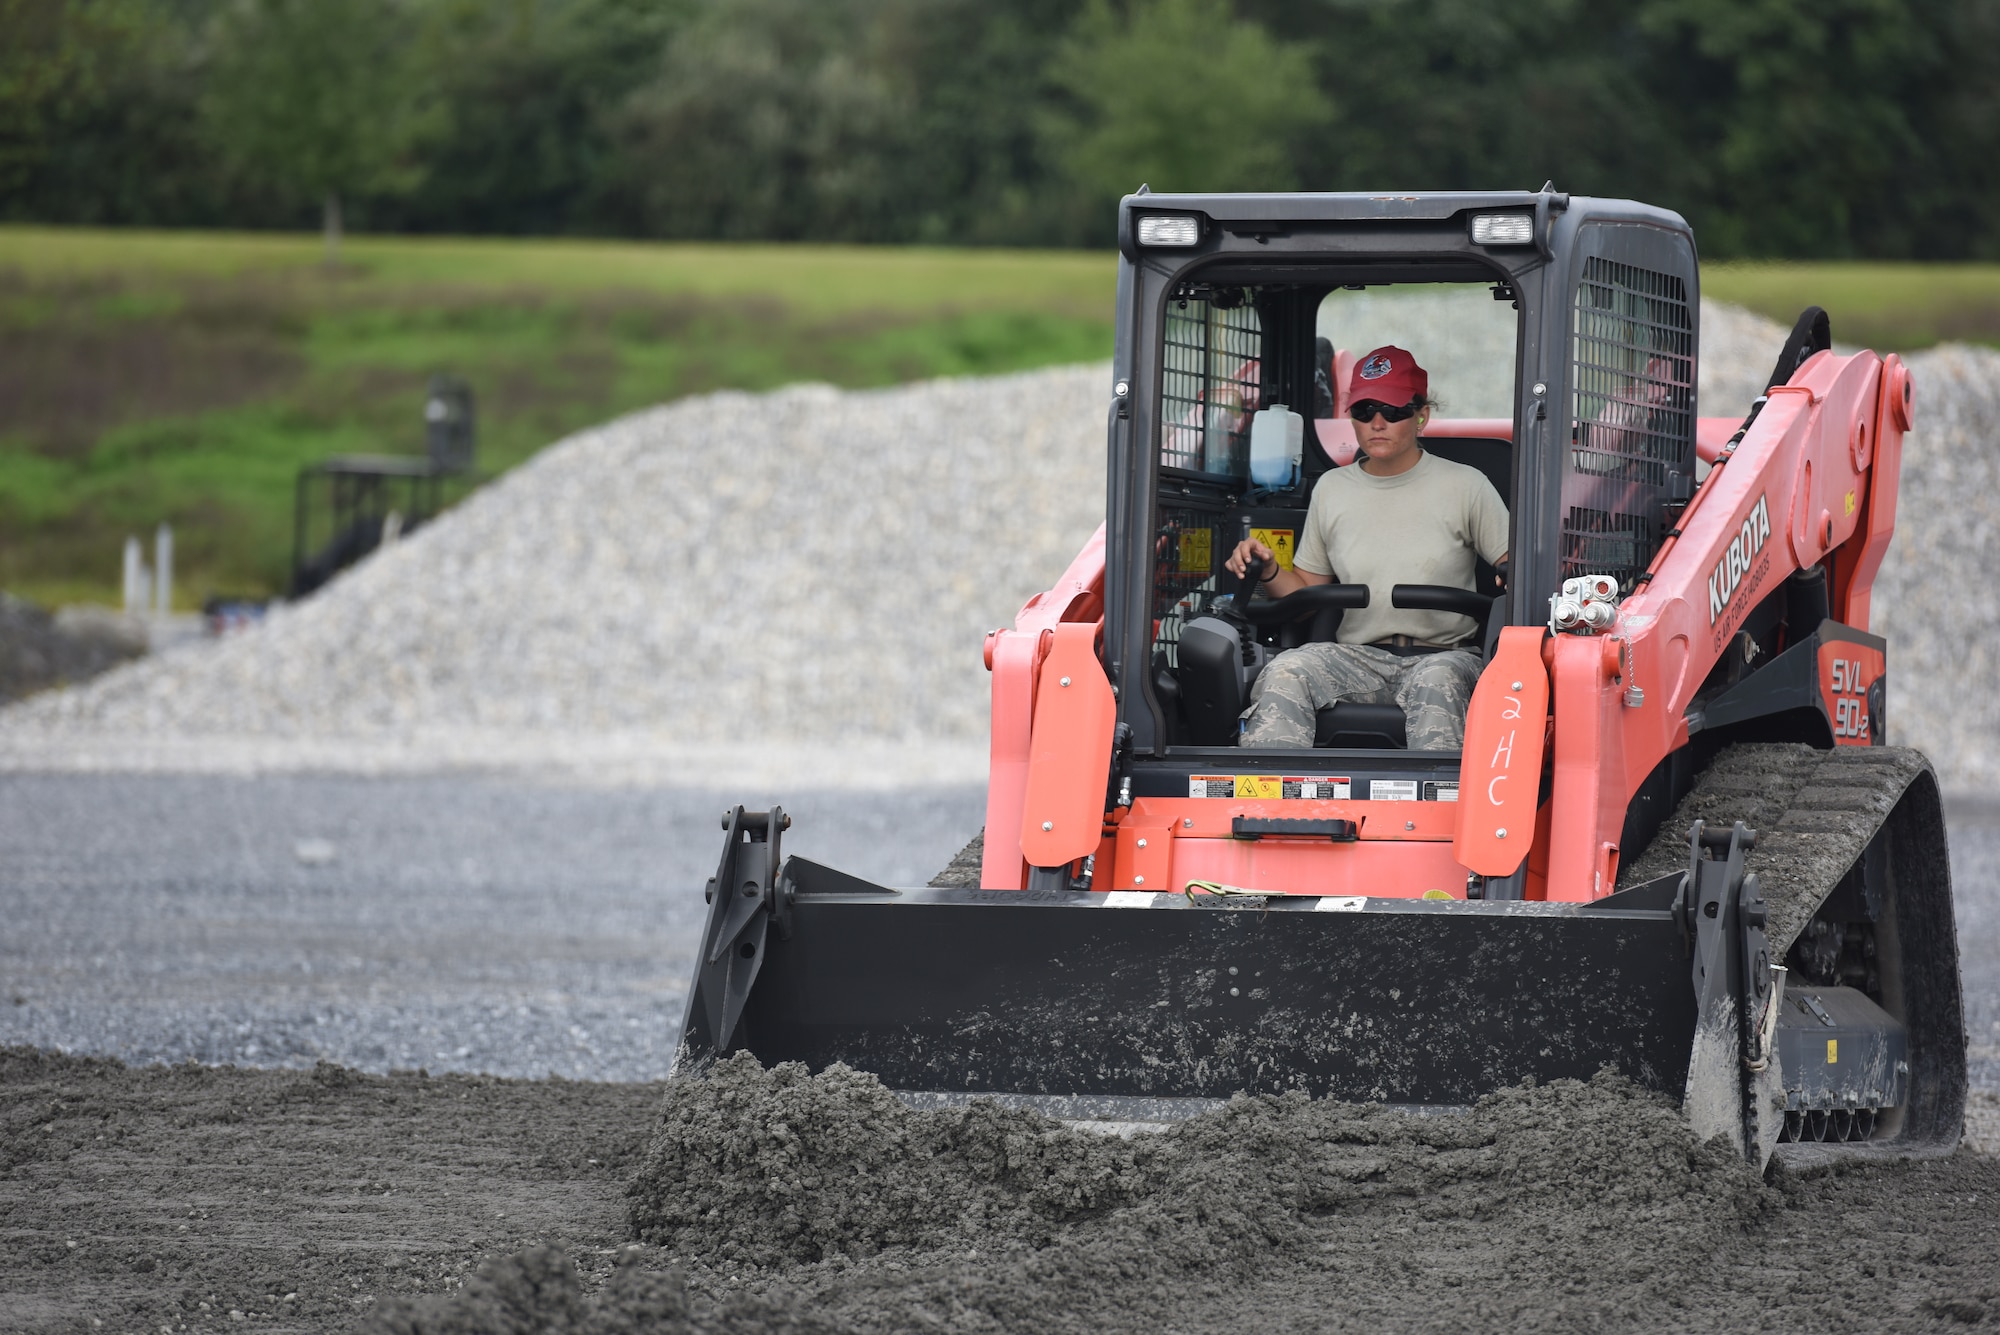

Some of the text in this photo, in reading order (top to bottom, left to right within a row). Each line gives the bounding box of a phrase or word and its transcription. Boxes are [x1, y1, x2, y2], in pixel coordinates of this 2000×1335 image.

[1708, 493, 1771, 627] KUBOTA
[1714, 630, 1722, 654] US
[1722, 615, 1731, 640] AIR
[1731, 587, 1748, 626] FORCE
[1831, 658, 1866, 695] SVL
[1835, 698, 1869, 739] 90-2
